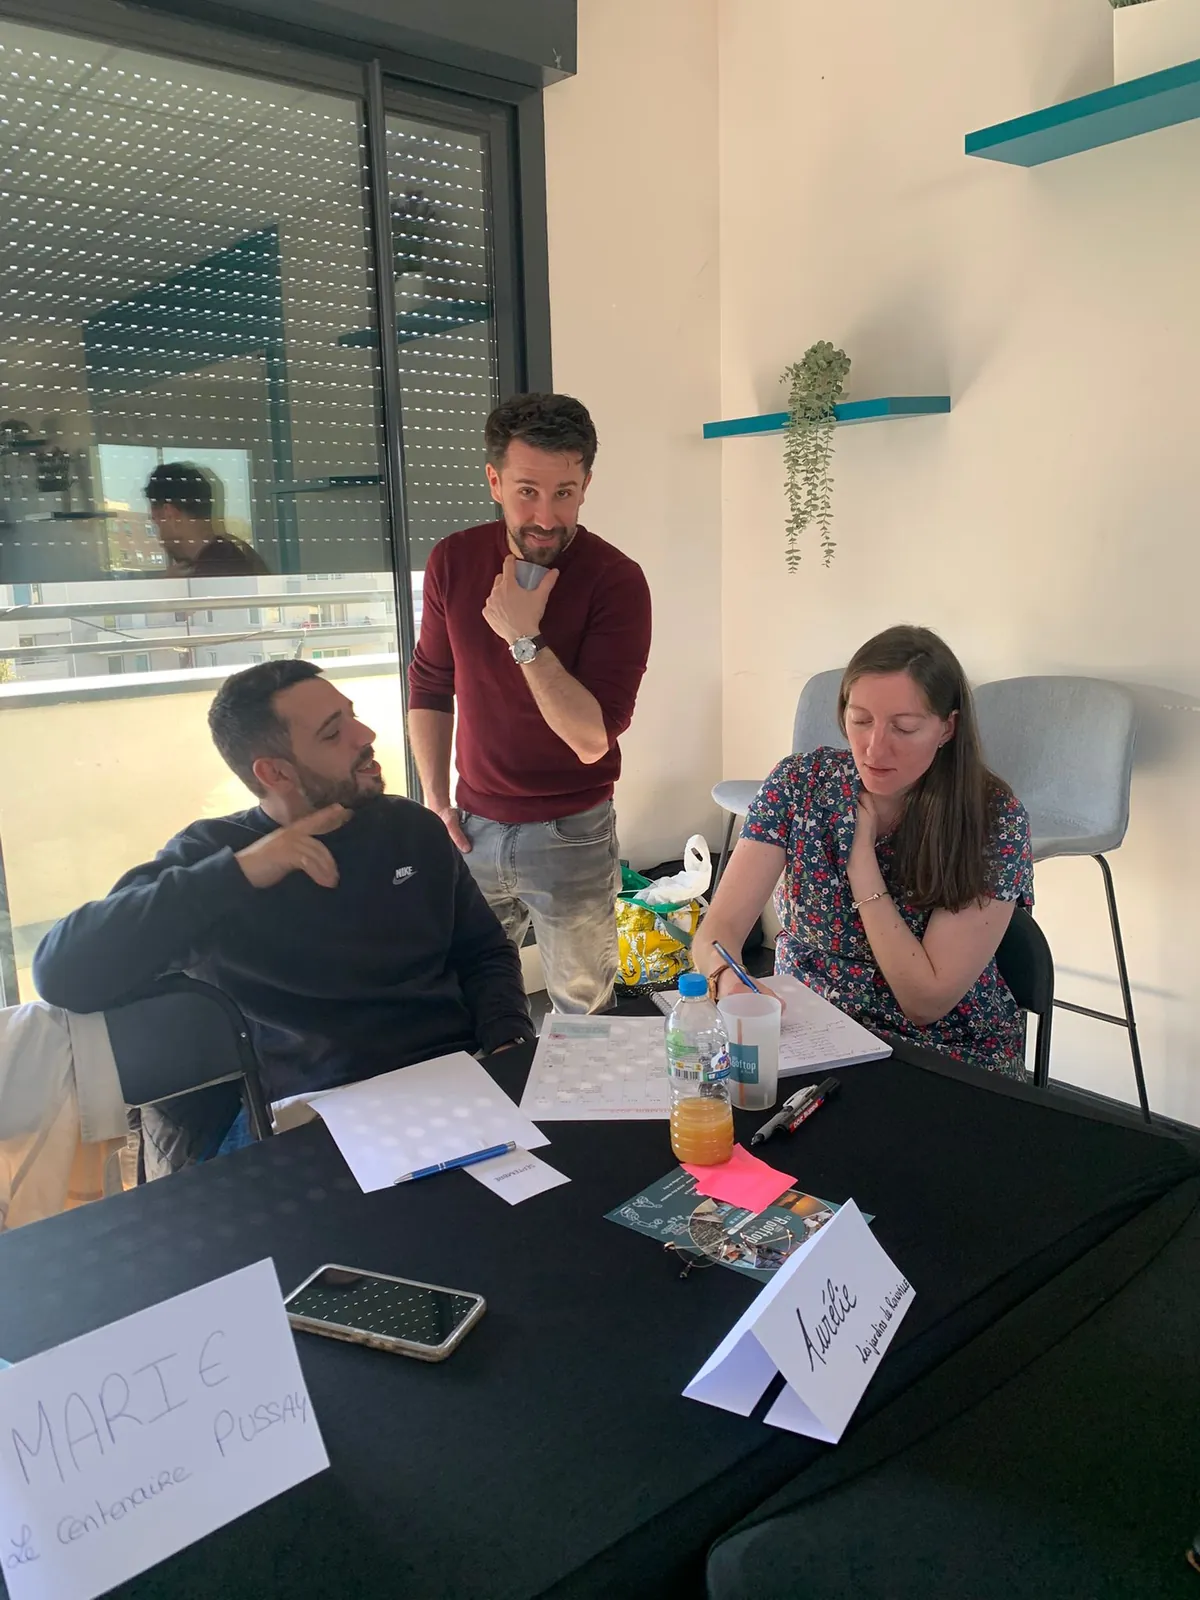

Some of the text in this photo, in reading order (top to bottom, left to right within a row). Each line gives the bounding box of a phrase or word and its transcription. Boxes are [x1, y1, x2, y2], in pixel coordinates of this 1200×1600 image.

[396, 866, 413, 878] NIKE
[744, 1216, 788, 1244] Rooftop
[796, 1278, 857, 1373] Aurélie
[855, 1344, 872, 1365] Les
[866, 1320, 888, 1356] jardins
[880, 1306, 893, 1321] de
[11, 1330, 232, 1485] MARIE
